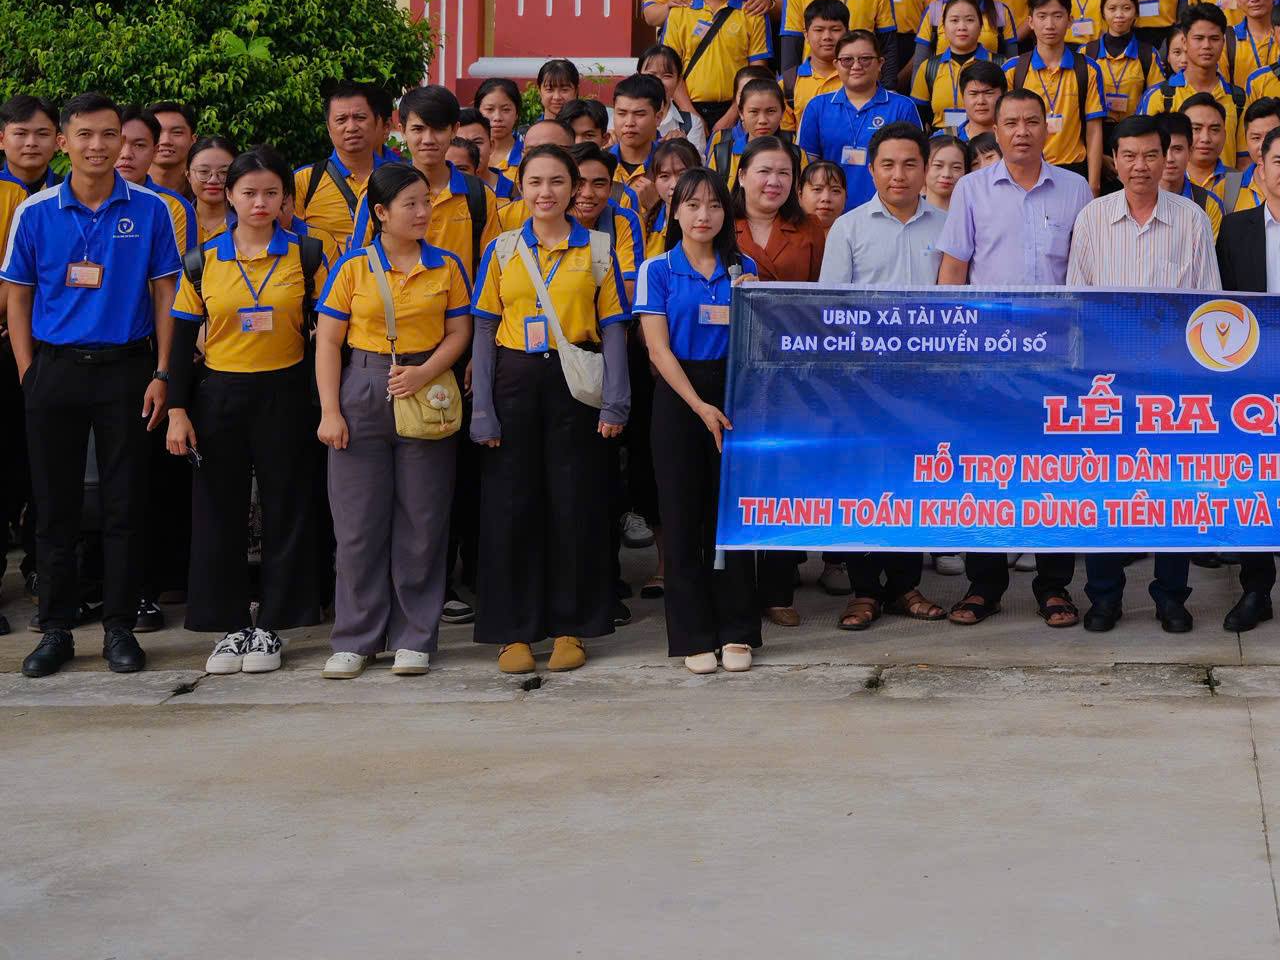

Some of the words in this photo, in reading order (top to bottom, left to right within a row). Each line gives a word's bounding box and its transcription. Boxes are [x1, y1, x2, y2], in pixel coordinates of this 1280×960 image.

[824, 310, 870, 324] UBND
[877, 308, 902, 324] XÃ
[908, 306, 934, 324] TÀI
[941, 307, 977, 324] VĂN
[782, 336, 817, 350] BAN
[824, 332, 855, 350] CHỈ
[861, 337, 901, 355] ĐẠO
[908, 329, 978, 351] CHUYỂN
[985, 330, 1016, 351] ĐỔI
[1023, 332, 1047, 351] SỐ
[1044, 374, 1122, 434] LỄ
[1136, 395, 1219, 433] RA
[914, 443, 953, 482] HỖ
[959, 455, 1016, 489] TRỢ
[1021, 448, 1109, 482] NGƯỜI
[1116, 448, 1171, 482] DÂN
[1177, 454, 1253, 487] THỰC
[739, 497, 833, 526] THANH
[839, 492, 913, 526] TOÁN
[920, 493, 1015, 527] KHÔNG
[1022, 494, 1097, 527] DÙNG
[1104, 490, 1165, 527] TIỀN
[1172, 492, 1229, 533] MẶT
[1234, 492, 1270, 526] VÀ
